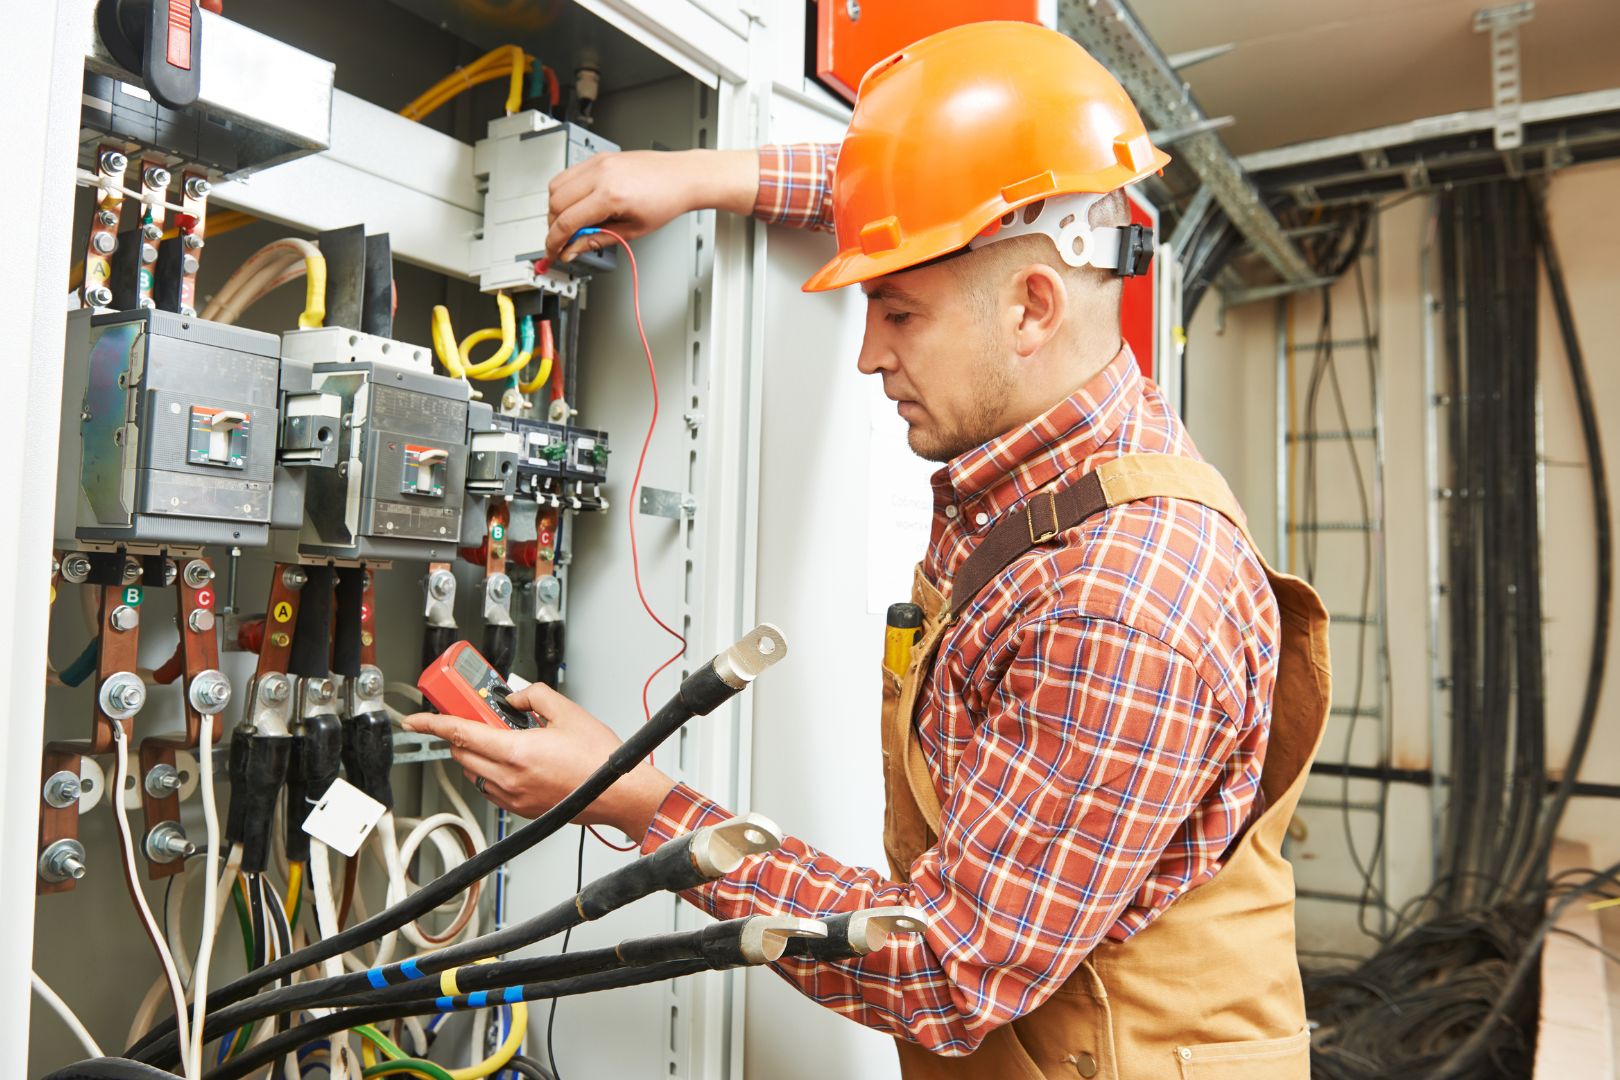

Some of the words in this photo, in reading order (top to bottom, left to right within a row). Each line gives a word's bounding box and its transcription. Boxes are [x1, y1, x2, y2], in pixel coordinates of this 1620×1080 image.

[93, 261, 106, 277] A
[494, 526, 503, 539] B
[541, 532, 550, 544] C
[126, 588, 140, 603] B
[198, 591, 210, 605] C
[278, 605, 288, 618] A
